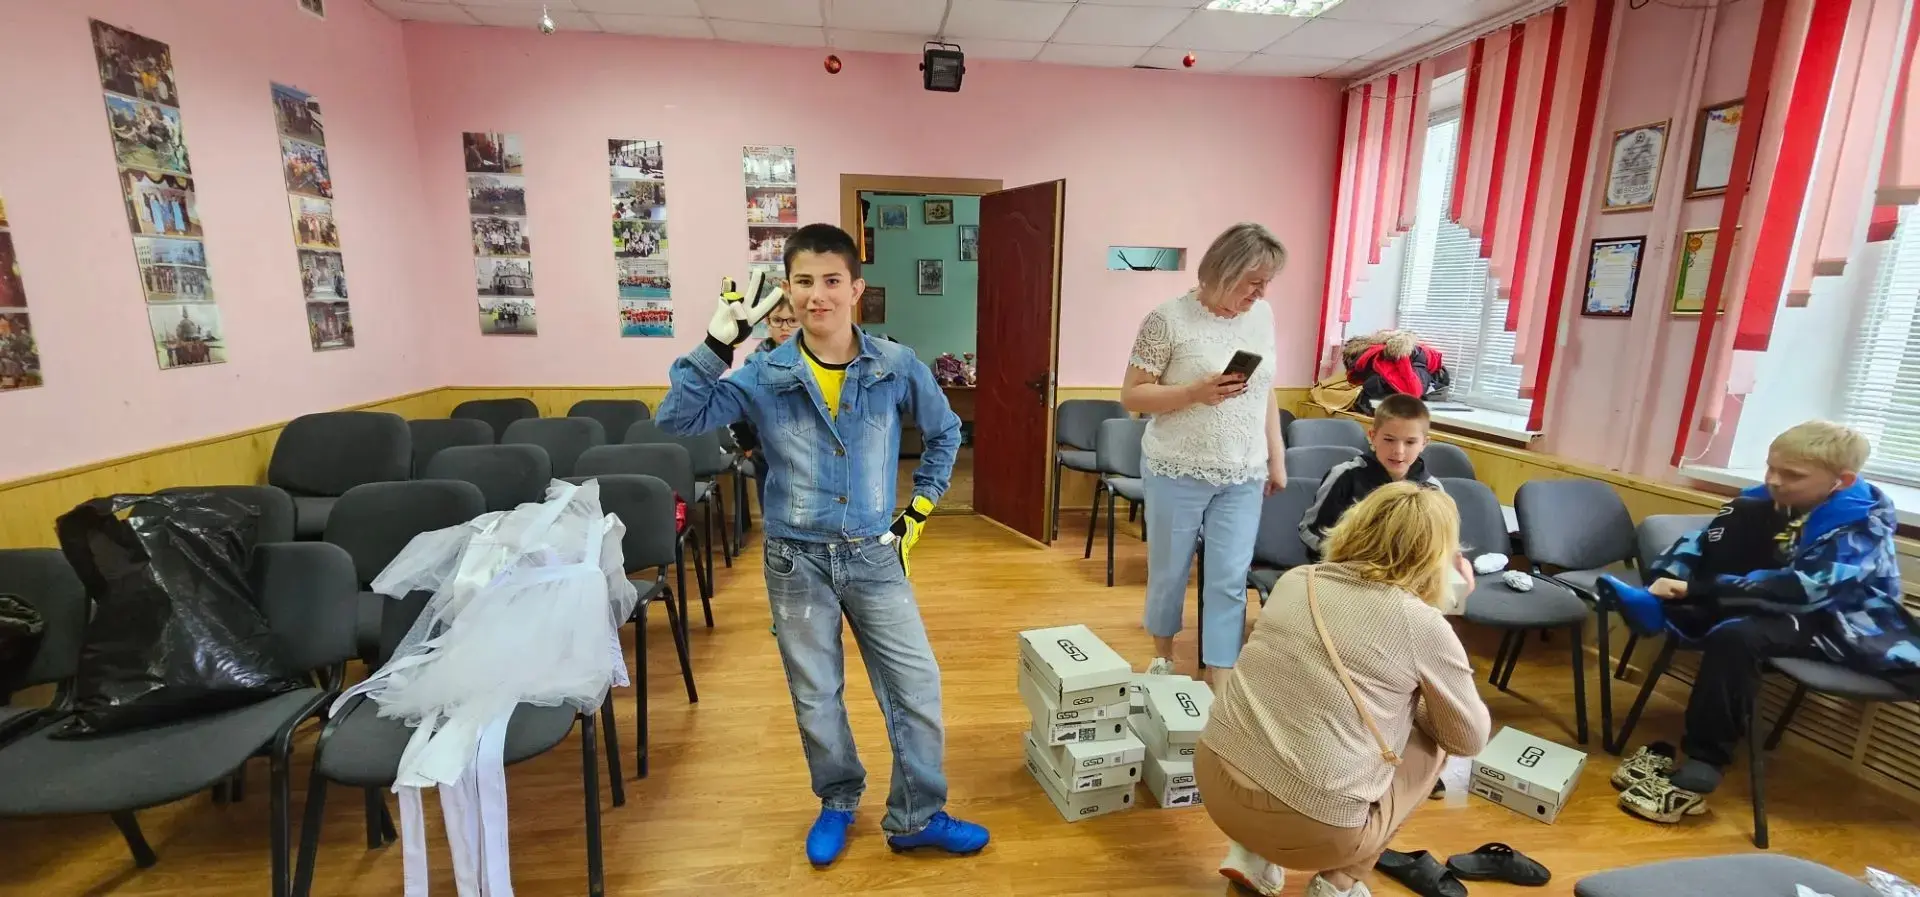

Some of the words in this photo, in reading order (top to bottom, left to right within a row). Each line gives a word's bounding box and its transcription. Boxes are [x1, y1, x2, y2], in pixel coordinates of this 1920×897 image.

[1057, 639, 1088, 661] GSD
[1073, 697, 1094, 705] GSD
[1176, 692, 1200, 717] GSD
[1057, 710, 1079, 720] GSD
[1517, 746, 1545, 767] GSD
[1083, 757, 1104, 767] GSD
[1480, 766, 1506, 781] GSD
[1173, 776, 1194, 784] GSD
[1080, 805, 1099, 815] GSD
